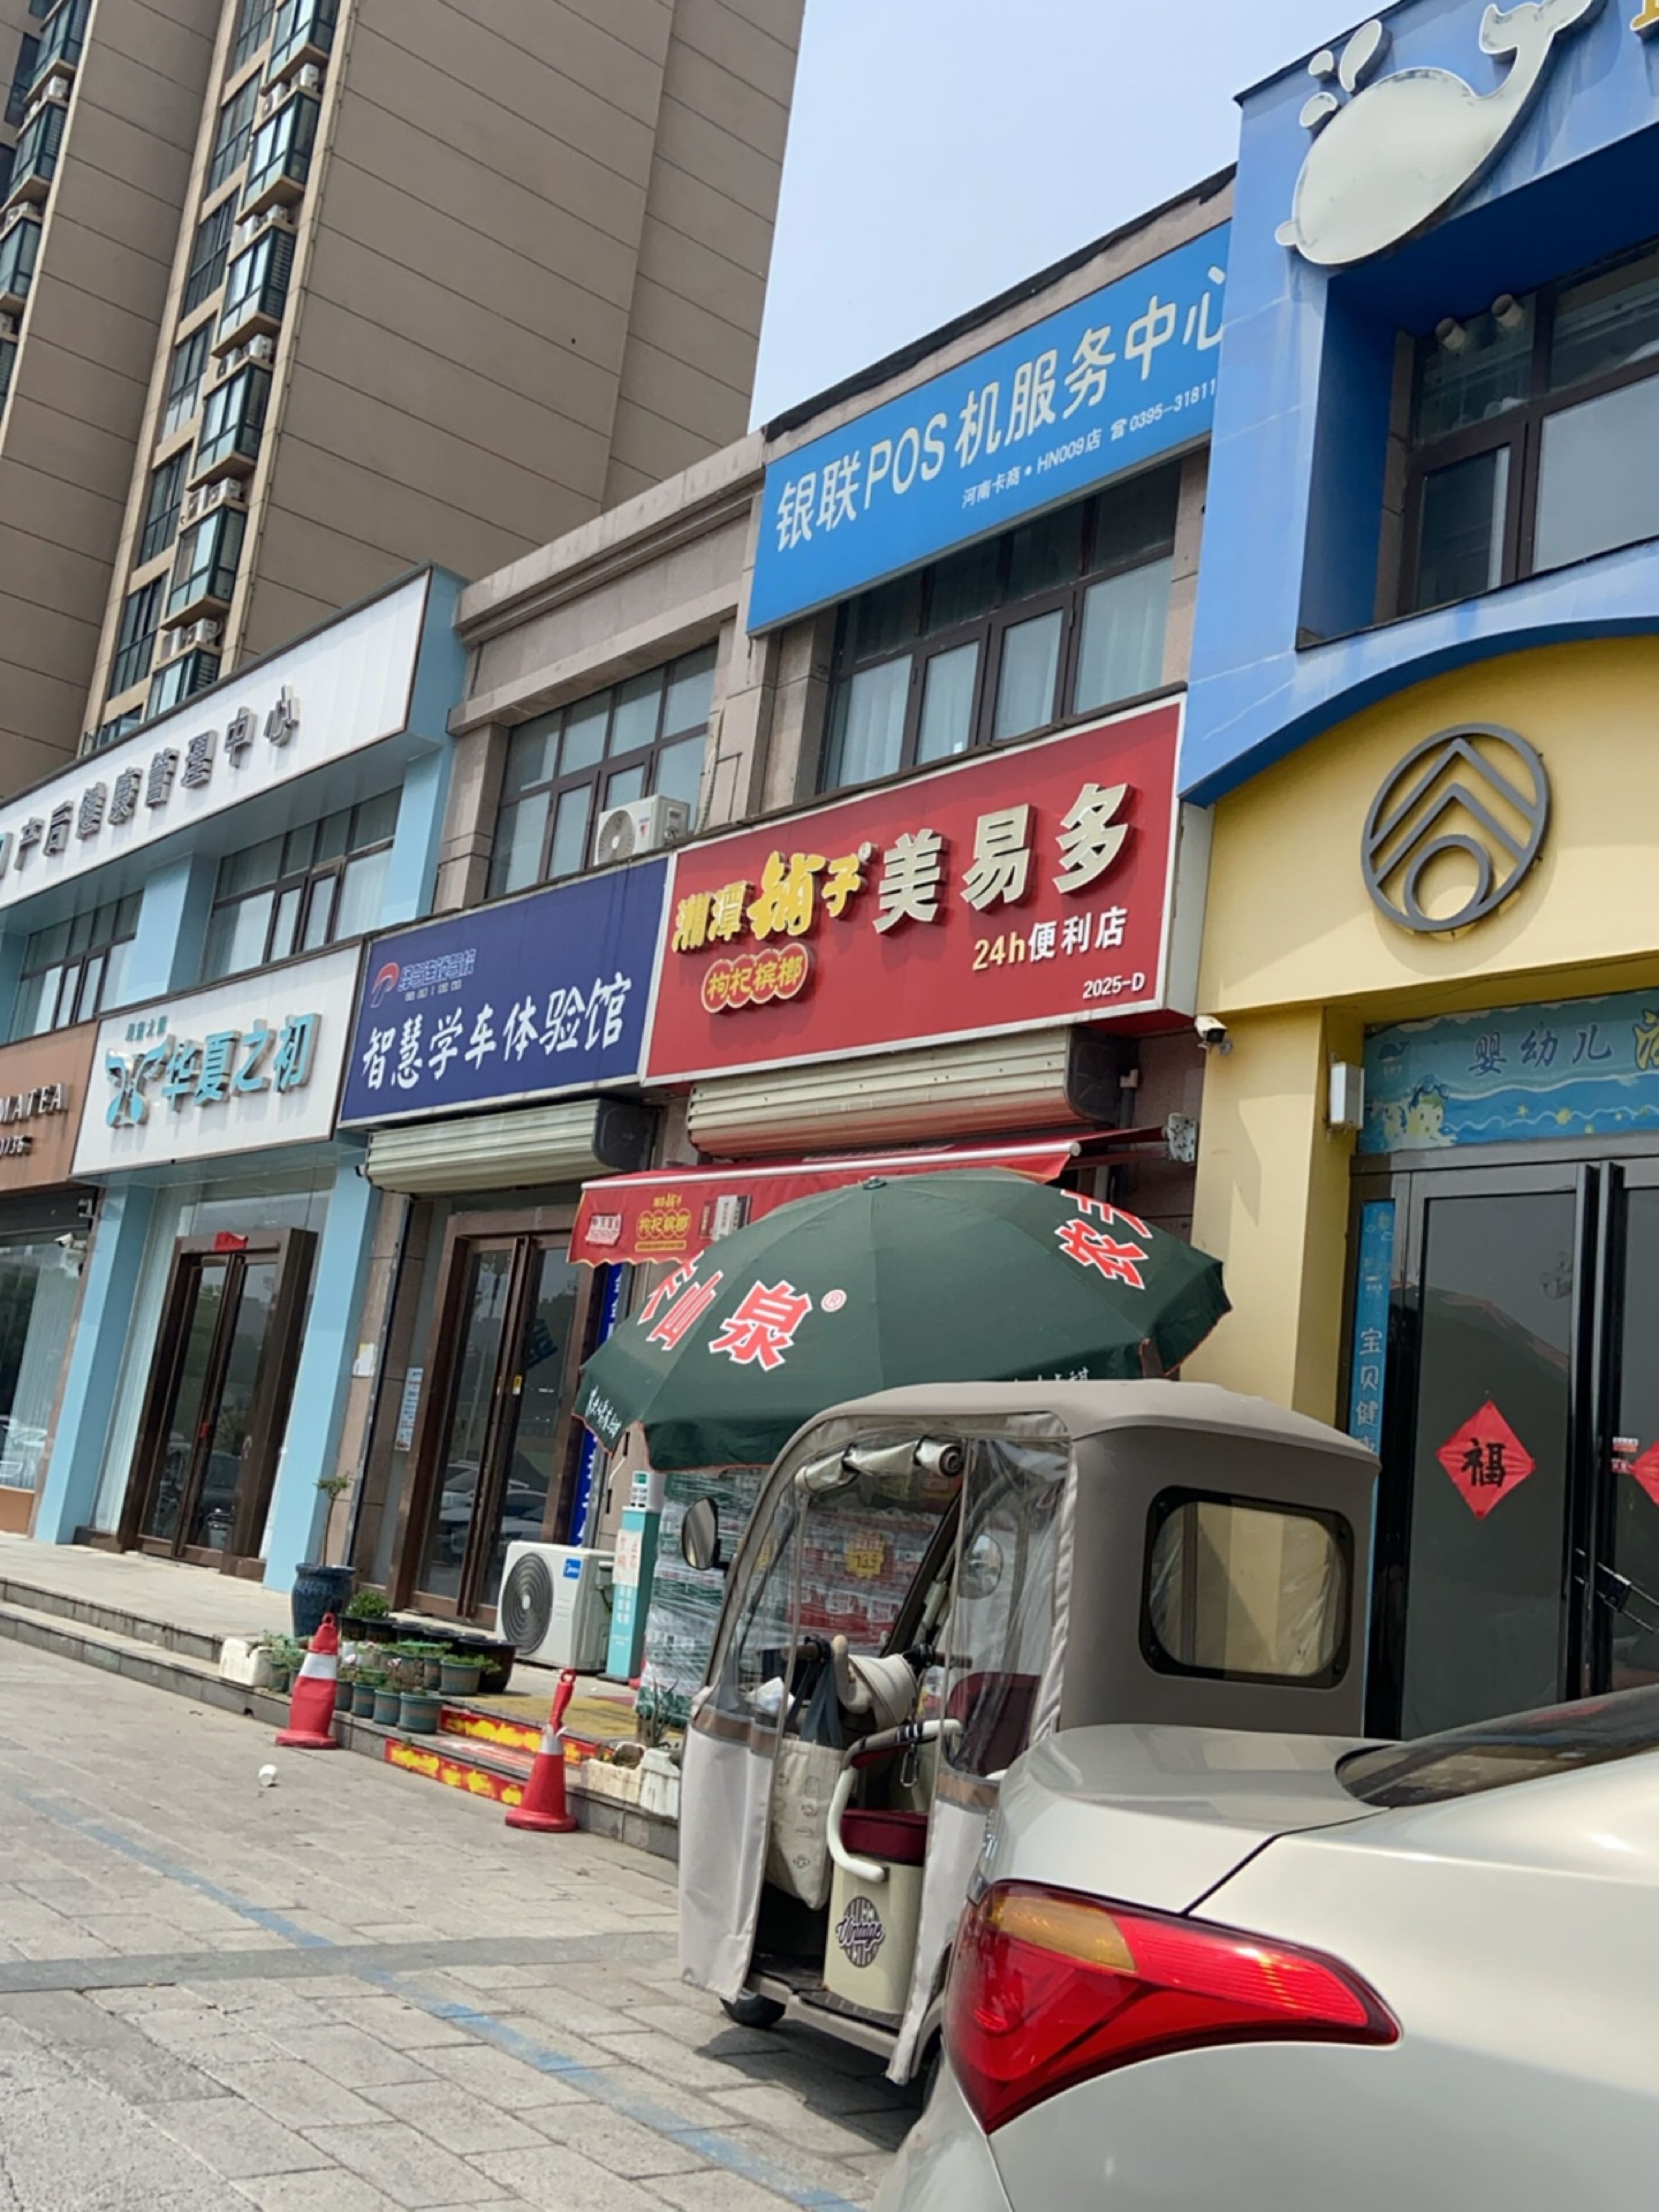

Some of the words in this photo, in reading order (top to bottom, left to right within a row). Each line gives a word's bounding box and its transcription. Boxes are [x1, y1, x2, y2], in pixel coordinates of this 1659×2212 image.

[0, 684, 300, 879] 产后健康管理中心
[872, 783, 1130, 934] 美易多
[707, 954, 805, 1001] 枸杞槟榔
[972, 905, 1128, 972] 24h便利店
[1082, 971, 1146, 1000] 2025-D
[161, 1013, 322, 1112] 华夏之初
[361, 972, 632, 1090] 智慧学车体验馆
[1460, 1437, 1507, 1488] 福
